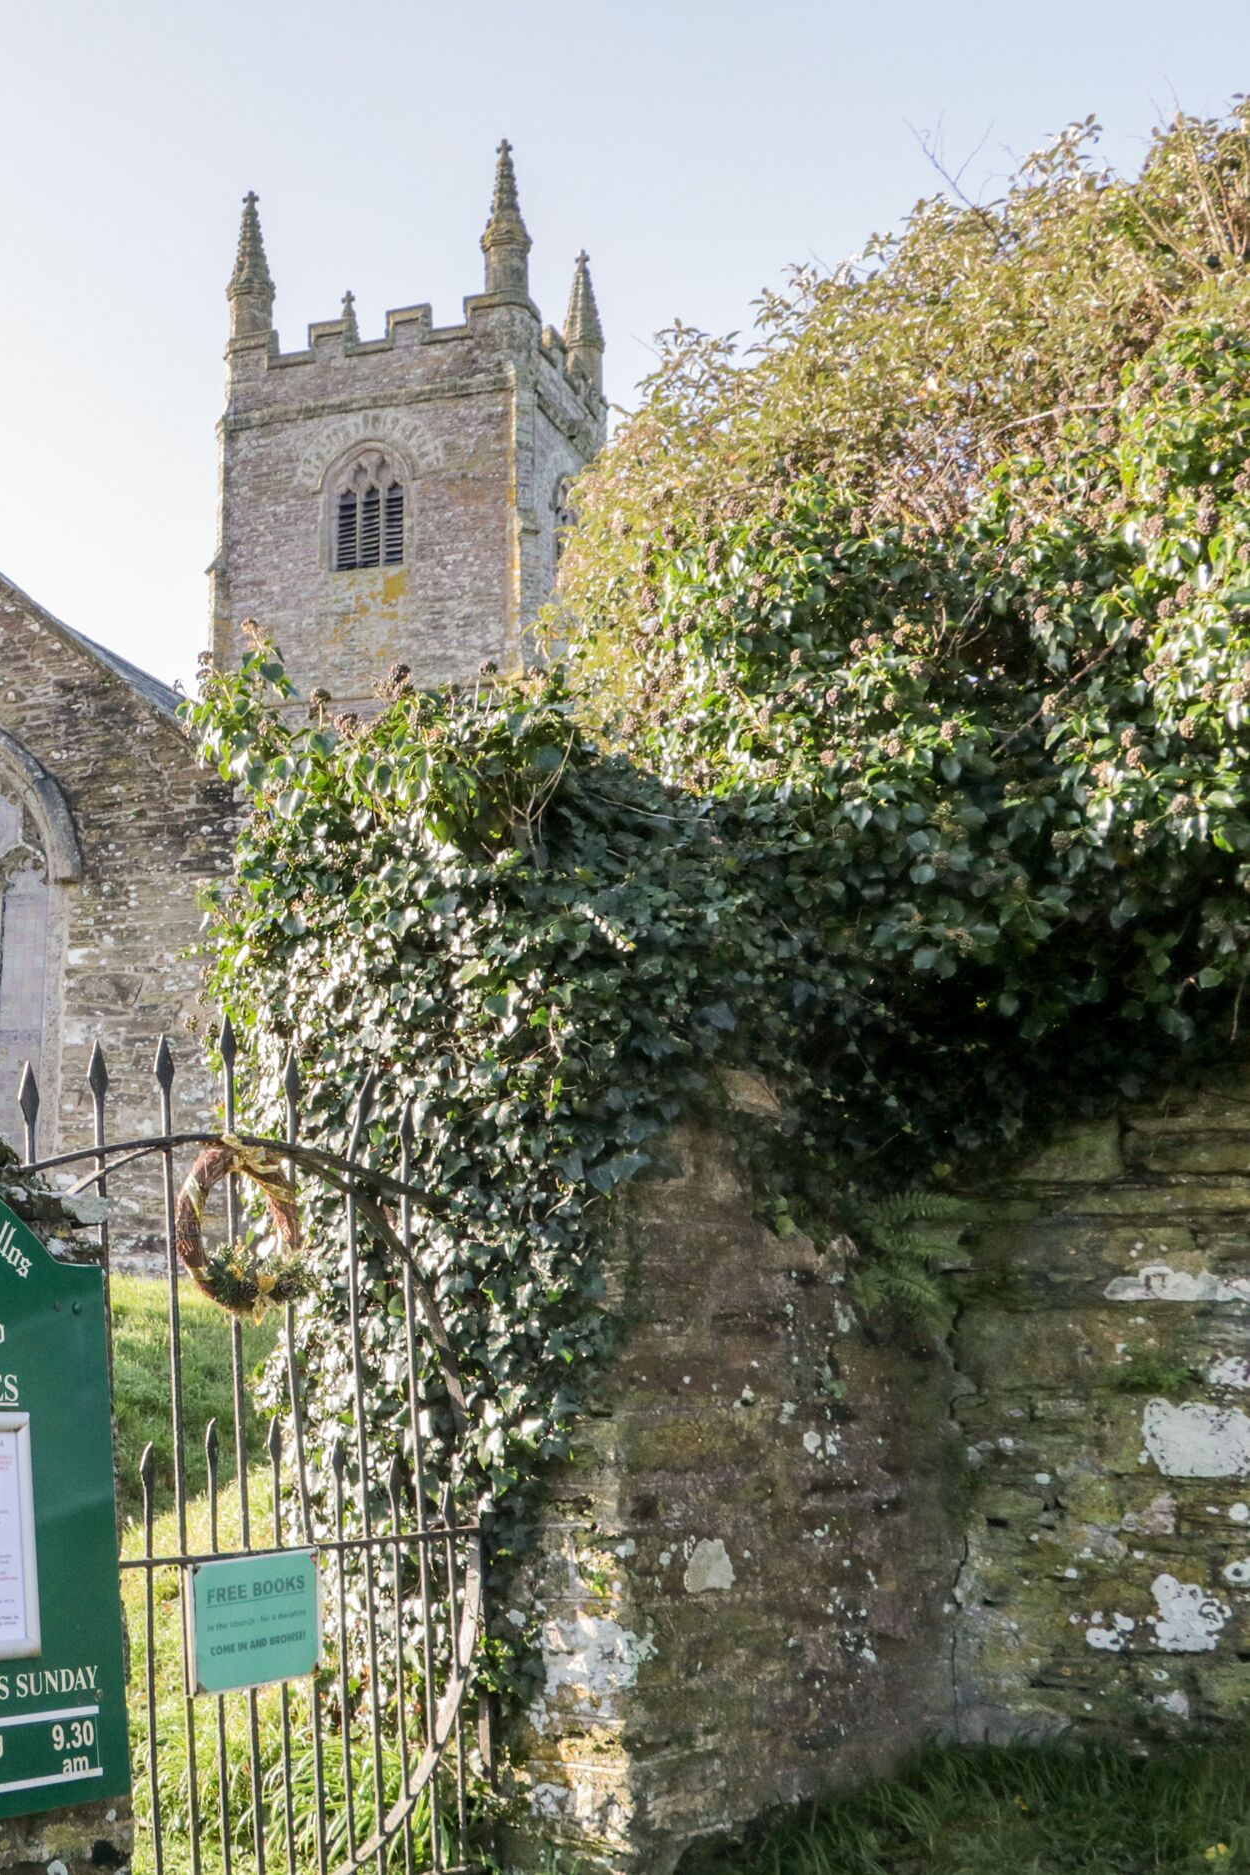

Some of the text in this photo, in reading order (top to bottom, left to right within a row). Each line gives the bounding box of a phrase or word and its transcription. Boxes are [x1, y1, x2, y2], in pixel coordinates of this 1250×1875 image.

[206, 1575, 306, 1605] FREE BOOKS
[206, 1624, 215, 1632] in
[216, 1620, 228, 1630] the
[230, 1617, 255, 1629] church
[260, 1613, 270, 1623] for
[210, 1630, 306, 1657] COME IN AND BROWSE!
[16, 1665, 98, 1698] SUNDAY
[52, 1720, 95, 1751] 9.30
[62, 1754, 89, 1776] am
